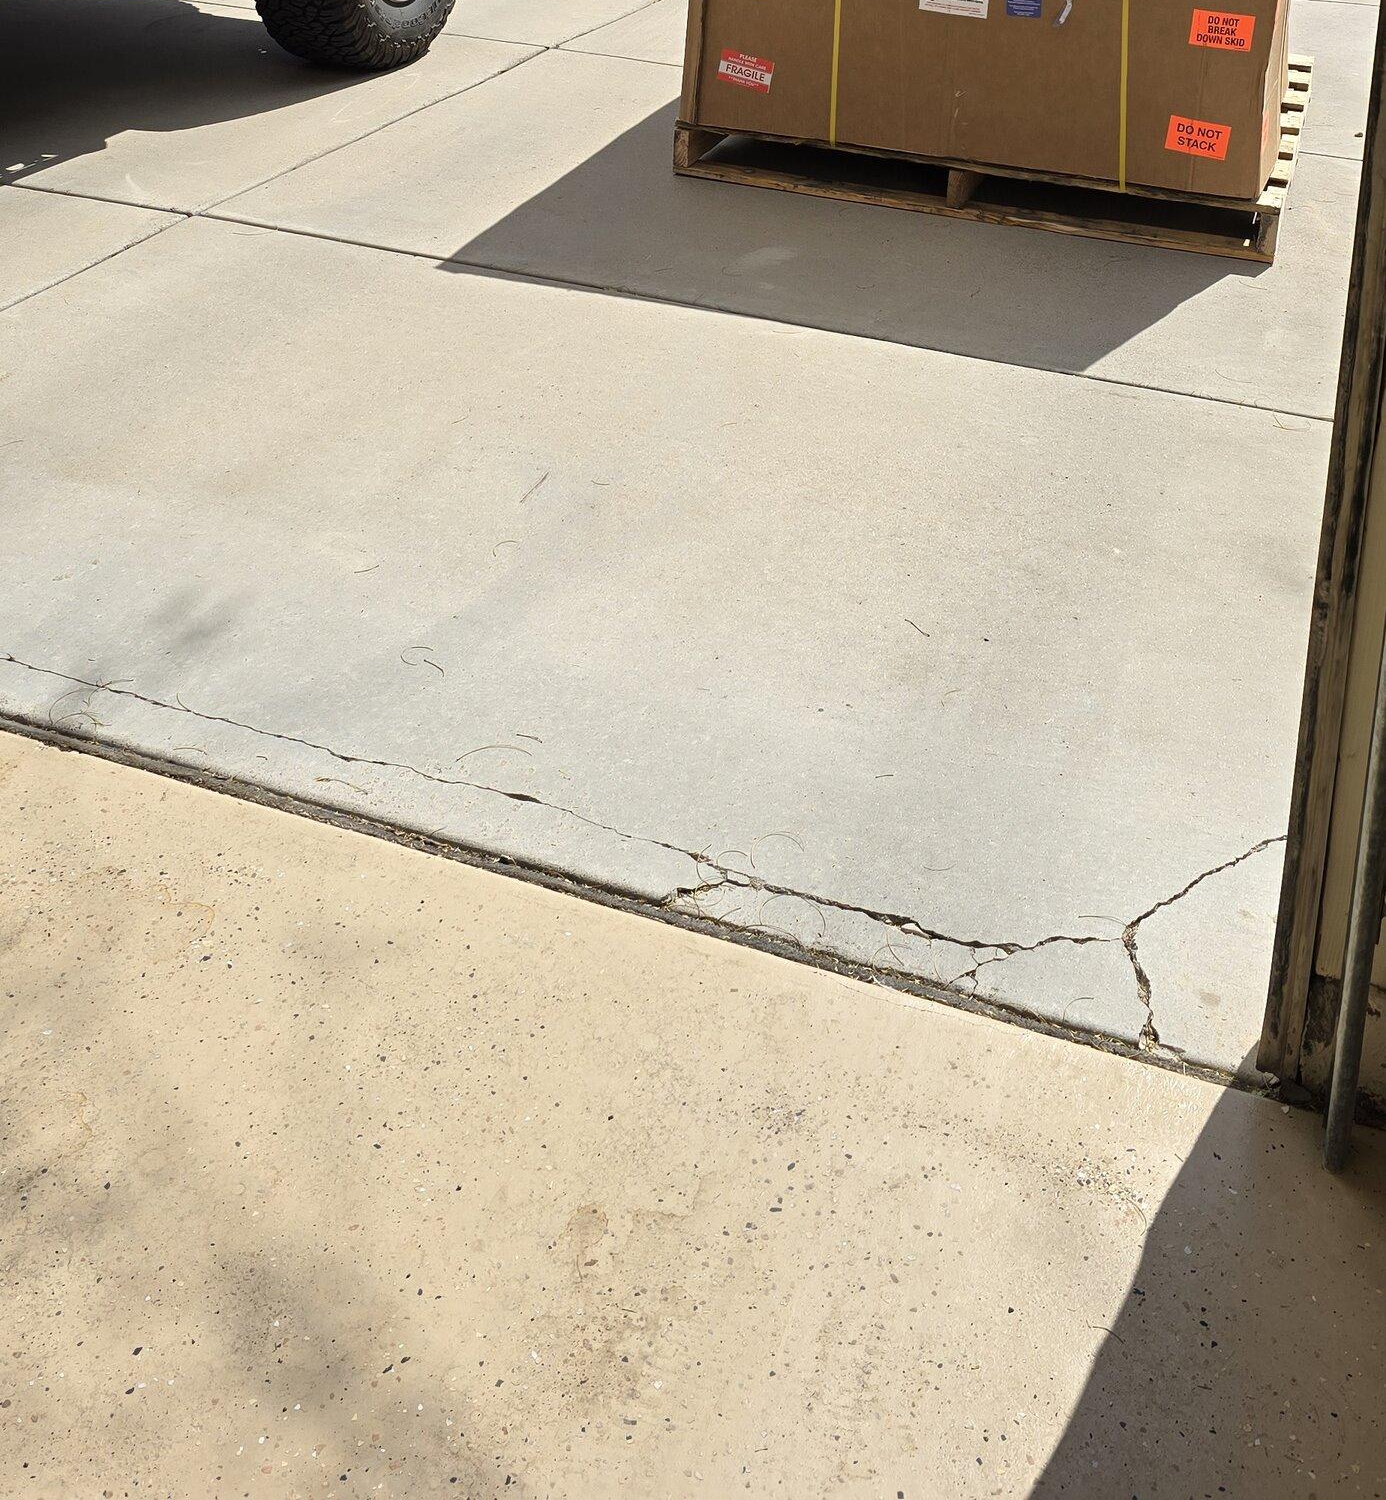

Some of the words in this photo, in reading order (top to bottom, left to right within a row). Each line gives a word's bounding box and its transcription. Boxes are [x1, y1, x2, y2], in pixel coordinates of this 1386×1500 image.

[1207, 15, 1220, 25] DO
[1221, 17, 1240, 27] NOT
[1207, 25, 1238, 37] BREAK
[1196, 33, 1223, 45] DOWN
[1224, 36, 1245, 47] SKID
[739, 53, 758, 63] PLEASE
[725, 63, 766, 82] FRAGILE
[1176, 122, 1195, 135] DO
[1197, 127, 1223, 140] NOT
[1177, 135, 1217, 153] STACK
